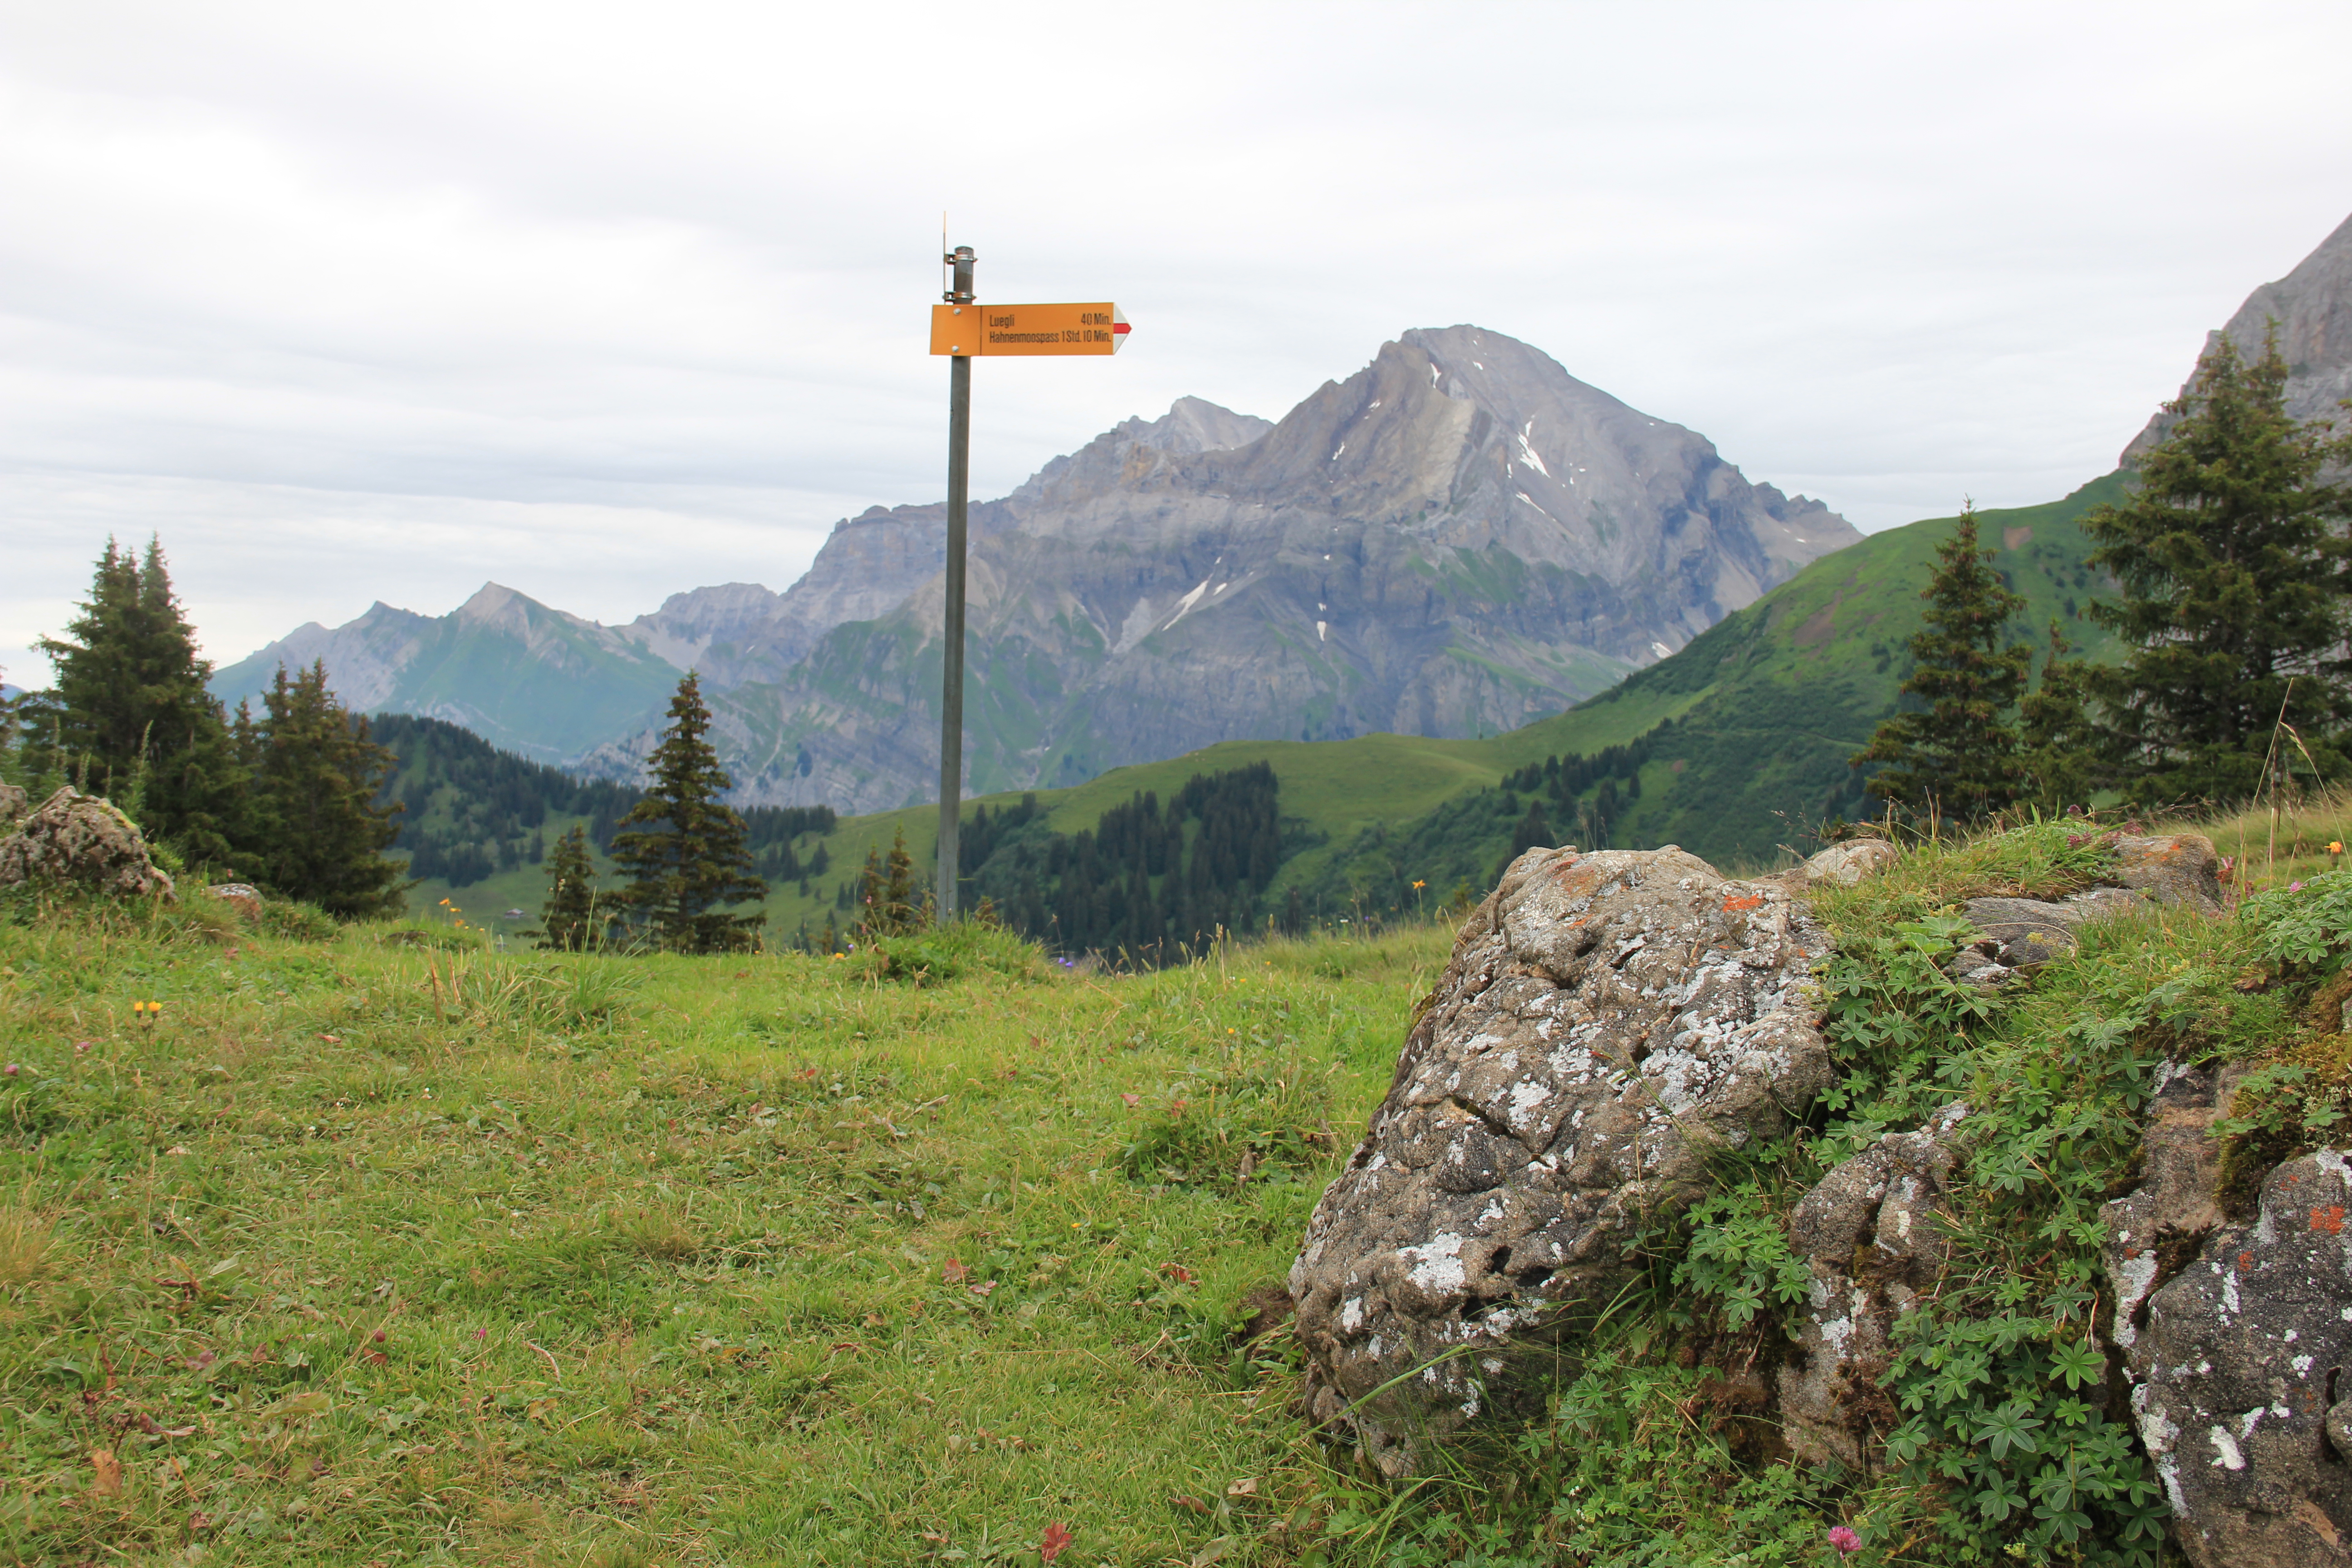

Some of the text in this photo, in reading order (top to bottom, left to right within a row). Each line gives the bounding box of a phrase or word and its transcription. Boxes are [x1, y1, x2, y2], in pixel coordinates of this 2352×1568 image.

[990, 313, 1111, 328] Luegli 40 Min.
[990, 331, 1059, 344] Hahnenmoospass
[1067, 330, 1082, 343] Std.
[1083, 330, 1092, 342] 10
[1094, 330, 1111, 342] Min.
